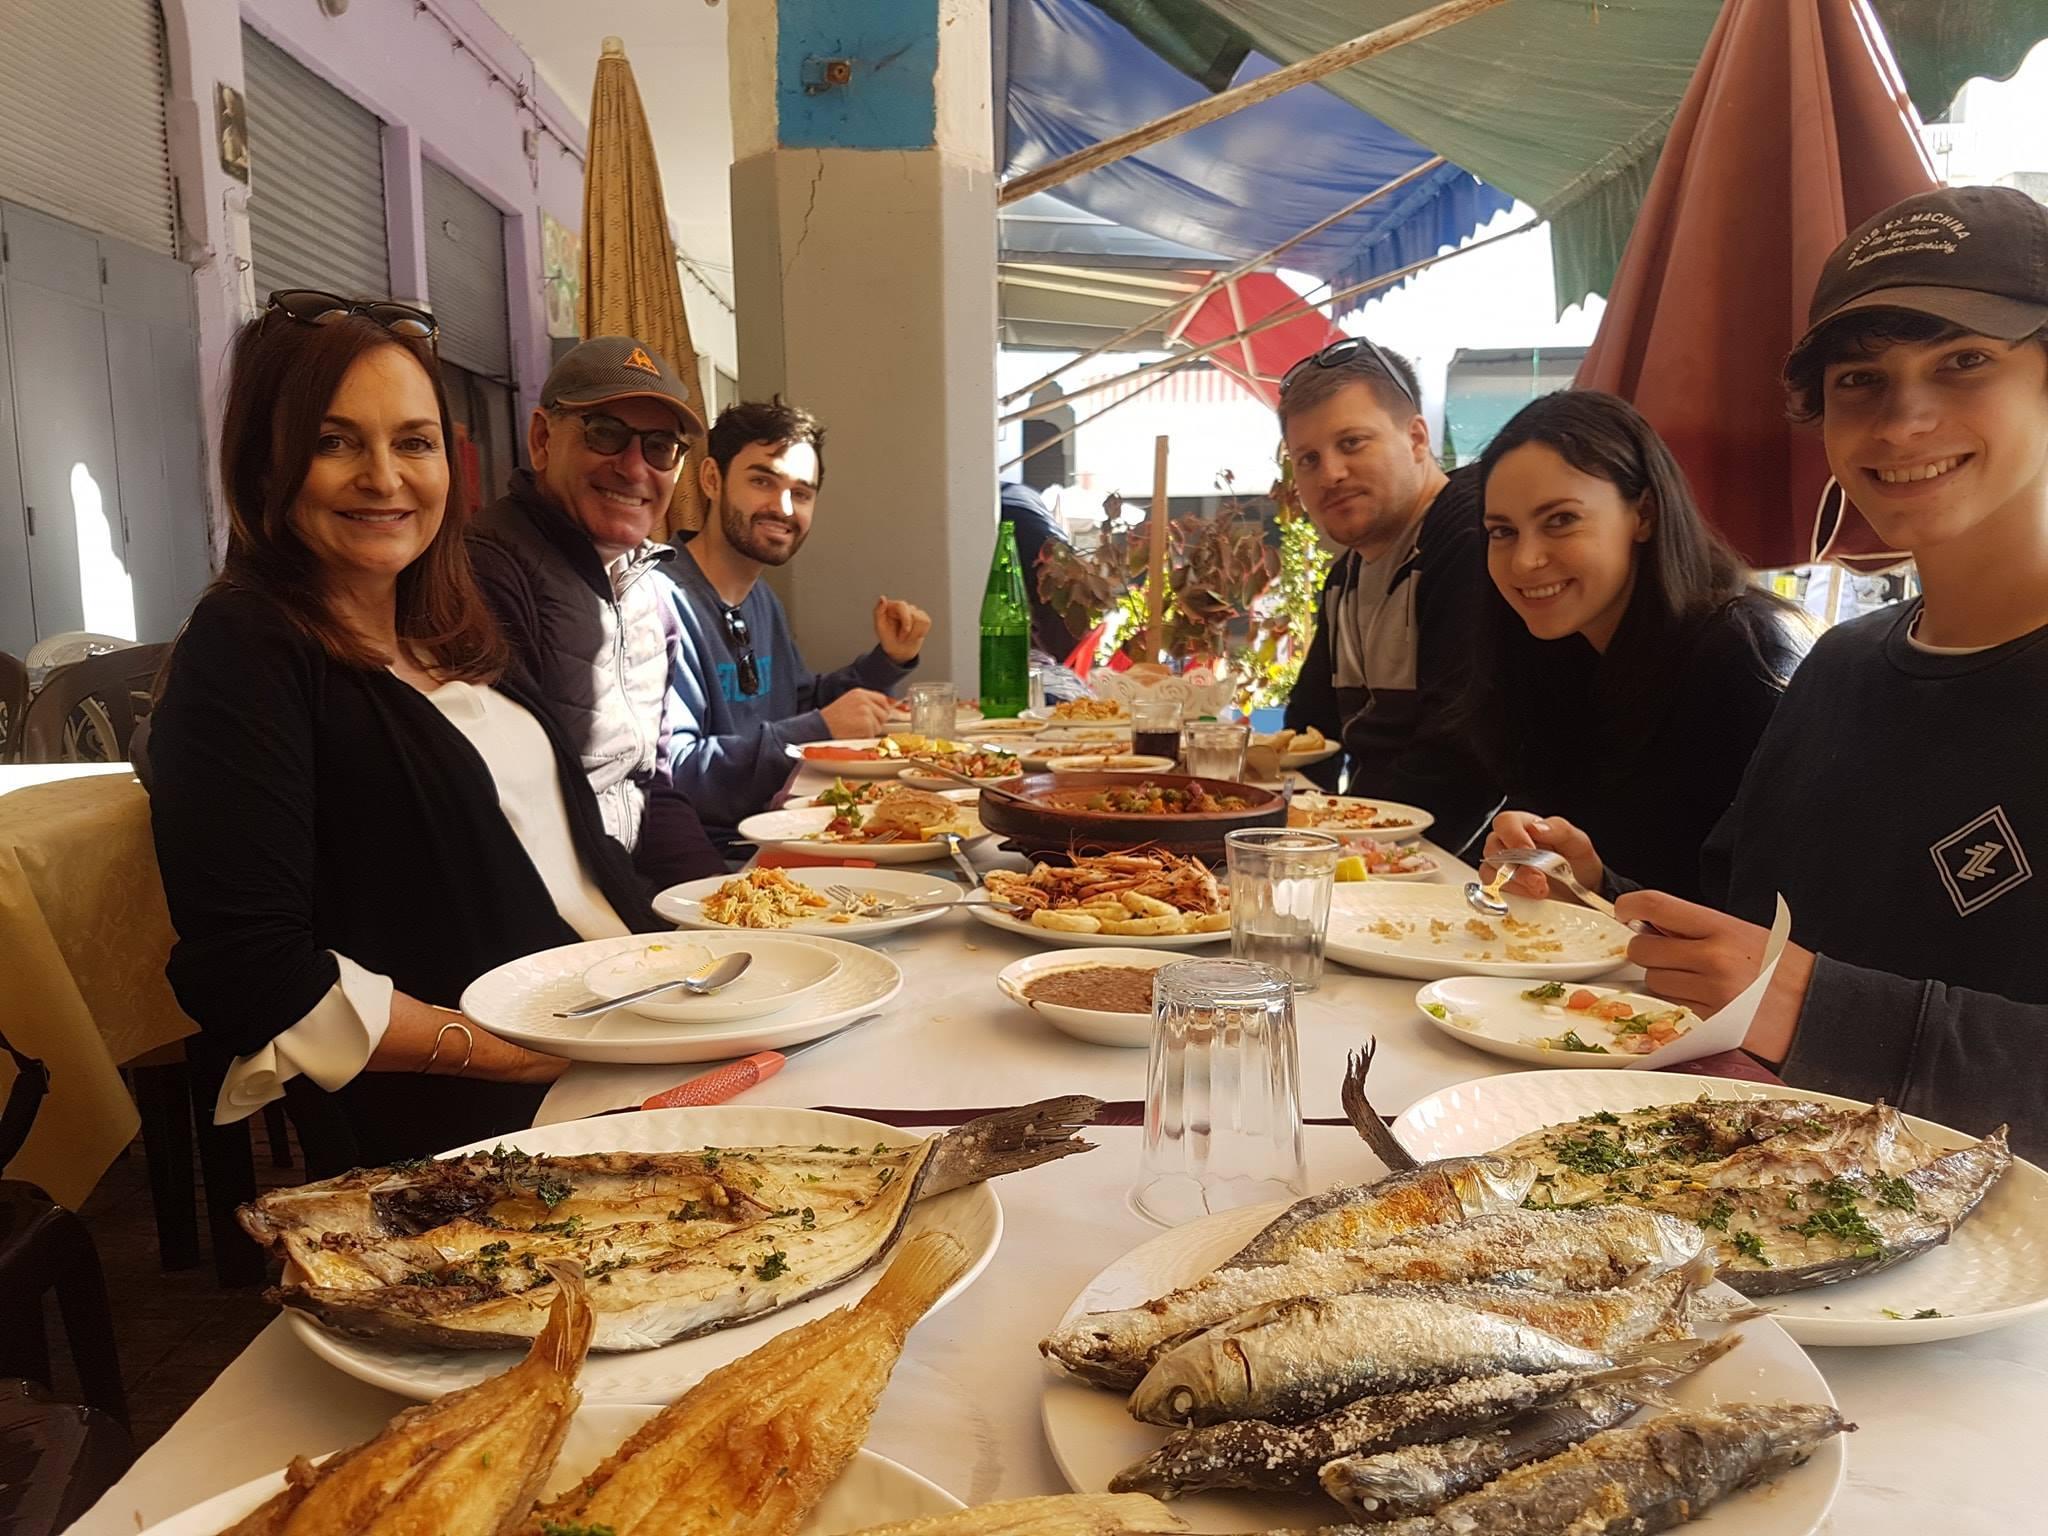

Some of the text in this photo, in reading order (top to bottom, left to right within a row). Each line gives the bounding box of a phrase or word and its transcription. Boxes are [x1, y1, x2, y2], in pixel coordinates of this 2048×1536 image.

[1848, 212, 1971, 260] DEUS EX MACHINA
